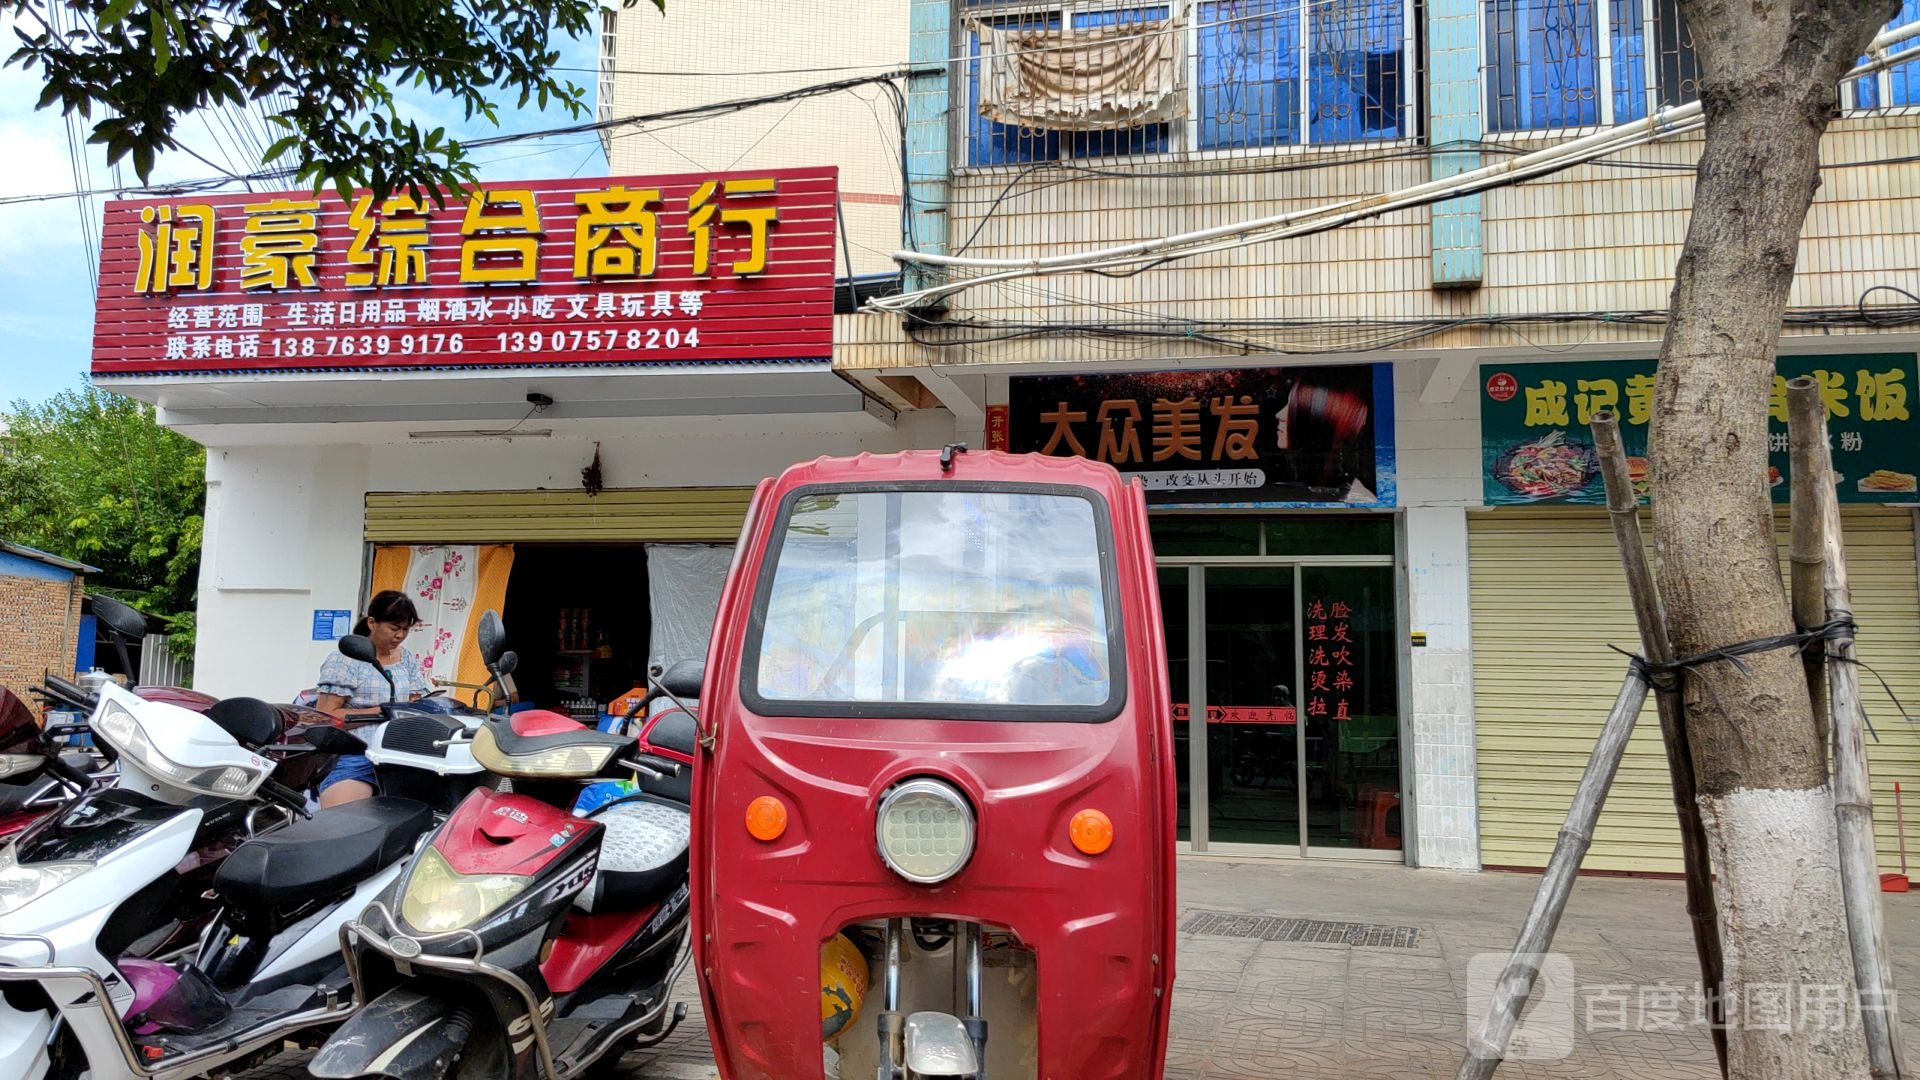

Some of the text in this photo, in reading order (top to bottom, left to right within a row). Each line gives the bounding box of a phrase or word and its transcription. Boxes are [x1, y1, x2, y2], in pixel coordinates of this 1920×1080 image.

[134, 177, 779, 293] 润豪综合商行
[167, 290, 704, 329] 经营范围 生活日用品 烟酒水 小吃 文具玩具等
[166, 334, 261, 359] 联系电话
[271, 337, 315, 358] 138
[325, 335, 391, 356] 7639
[401, 333, 464, 354] 9176
[1040, 396, 1260, 463] 大众美发
